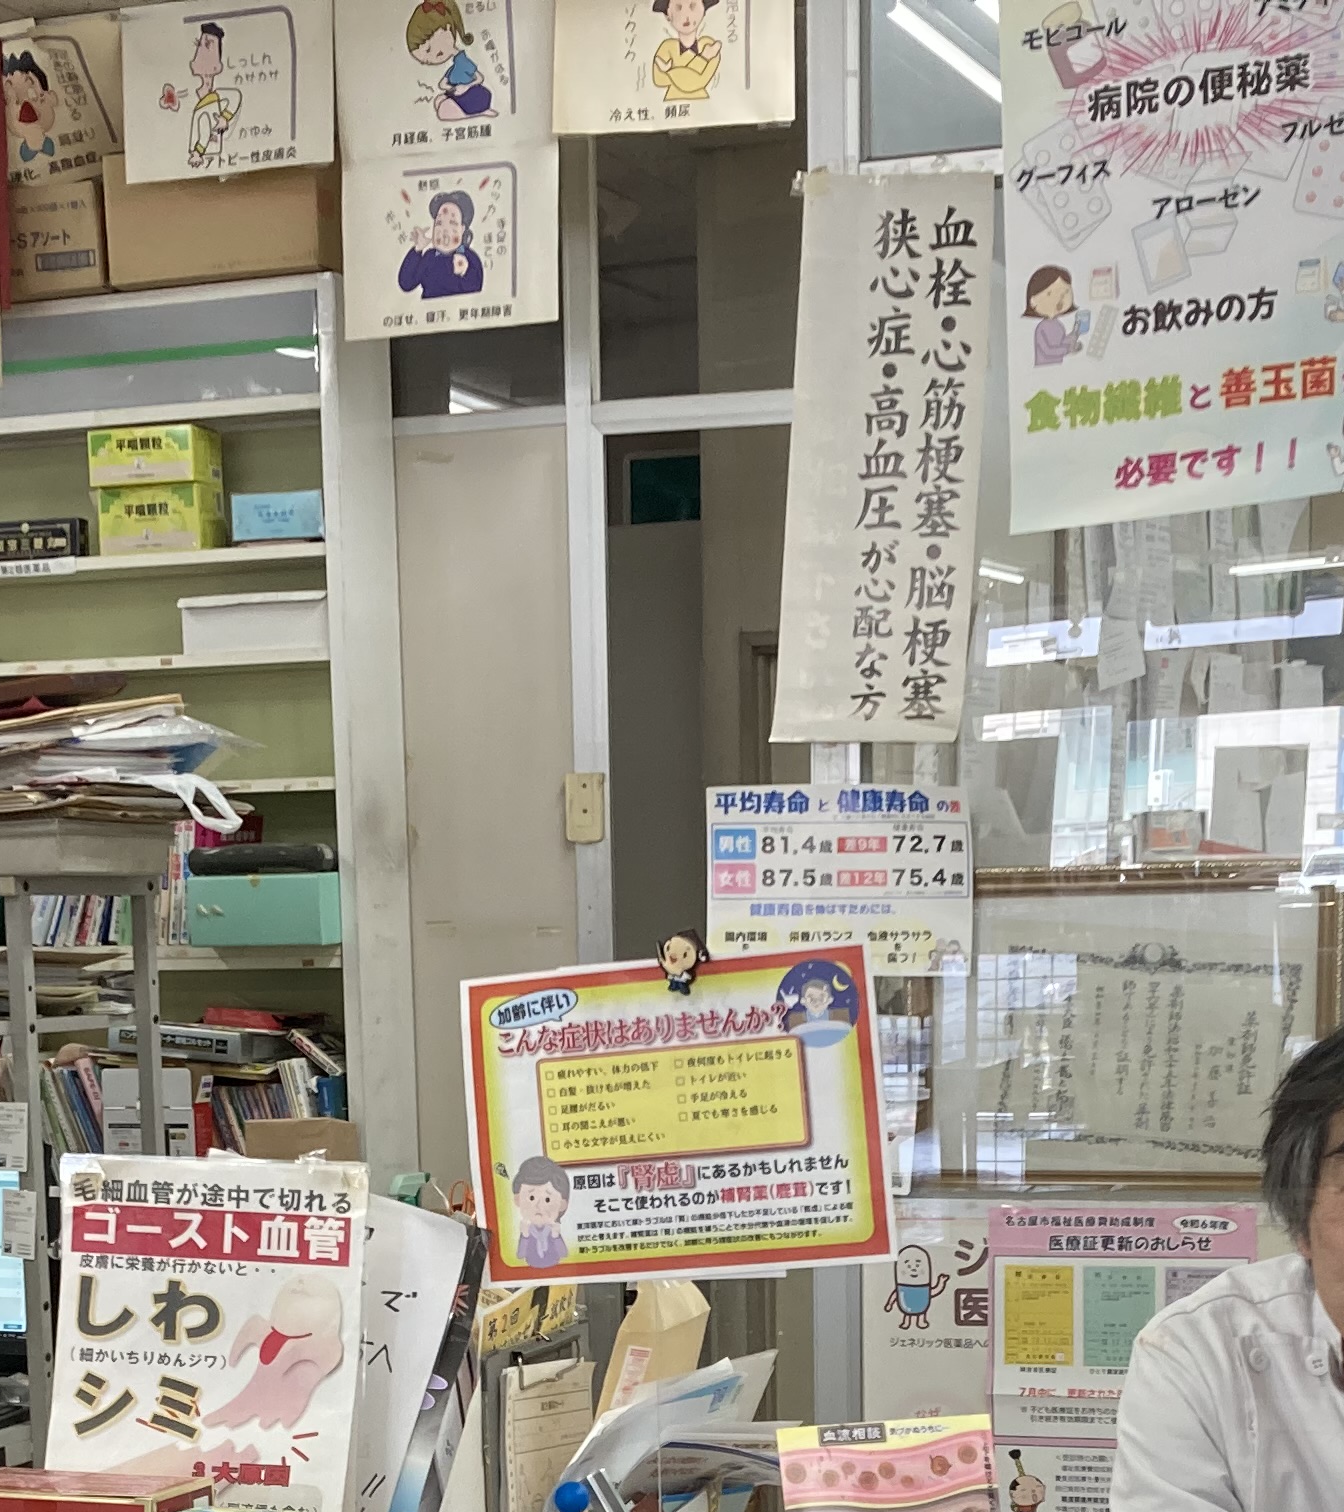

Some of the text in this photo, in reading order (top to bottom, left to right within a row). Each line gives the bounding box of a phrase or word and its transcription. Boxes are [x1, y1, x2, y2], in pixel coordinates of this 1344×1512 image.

[1021, 16, 1127, 51] モビコール
[1087, 52, 1314, 123] 病院の便秘薬
[1121, 286, 1279, 337] お飲みの方
[849, 207, 923, 722] 狭心症・高血圧が心配な方
[898, 204, 979, 722] 血栓・心筋梗塞・脳梗塞
[718, 869, 752, 889] 女性
[497, 992, 571, 1026] 加齢に伴い
[689, 1070, 747, 1086] トイレが近い
[563, 1132, 666, 1150] 小さな文字が見えにくい
[72, 1177, 354, 1215] 毛細血管が途中で切れる
[82, 1209, 348, 1262] ゴースト血管
[76, 1274, 225, 1347] しわ
[71, 1371, 204, 1441] シミ
